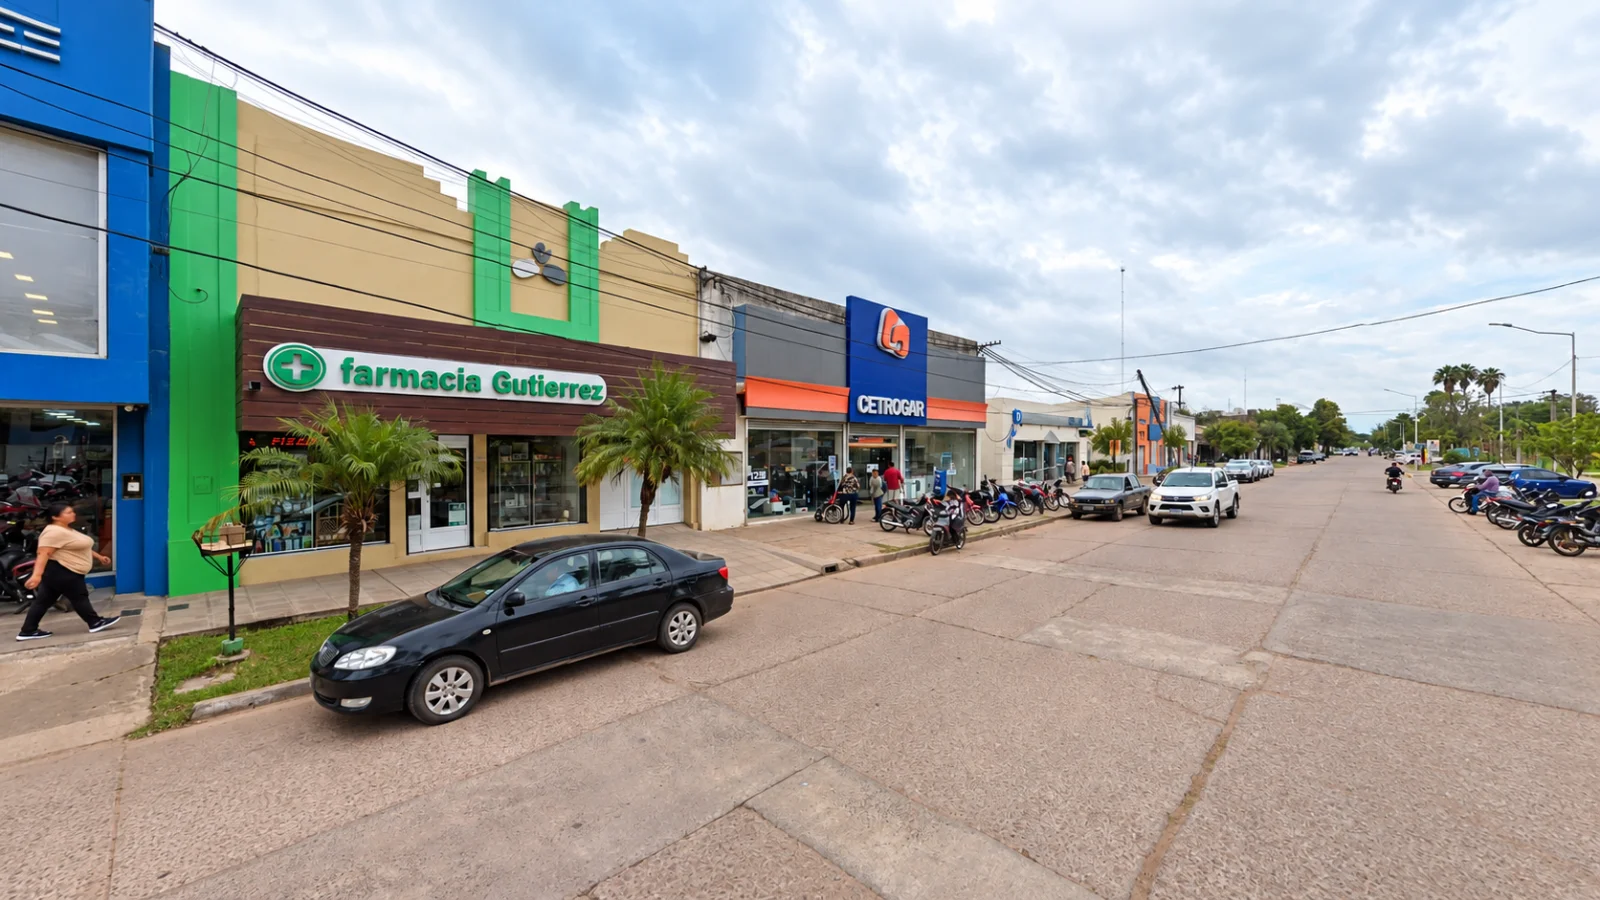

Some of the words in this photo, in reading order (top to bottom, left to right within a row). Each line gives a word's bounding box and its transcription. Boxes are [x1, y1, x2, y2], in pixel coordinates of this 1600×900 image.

[341, 357, 481, 393] farmacia
[492, 371, 603, 400] Gutierrez
[857, 395, 925, 417] CETROGAR
